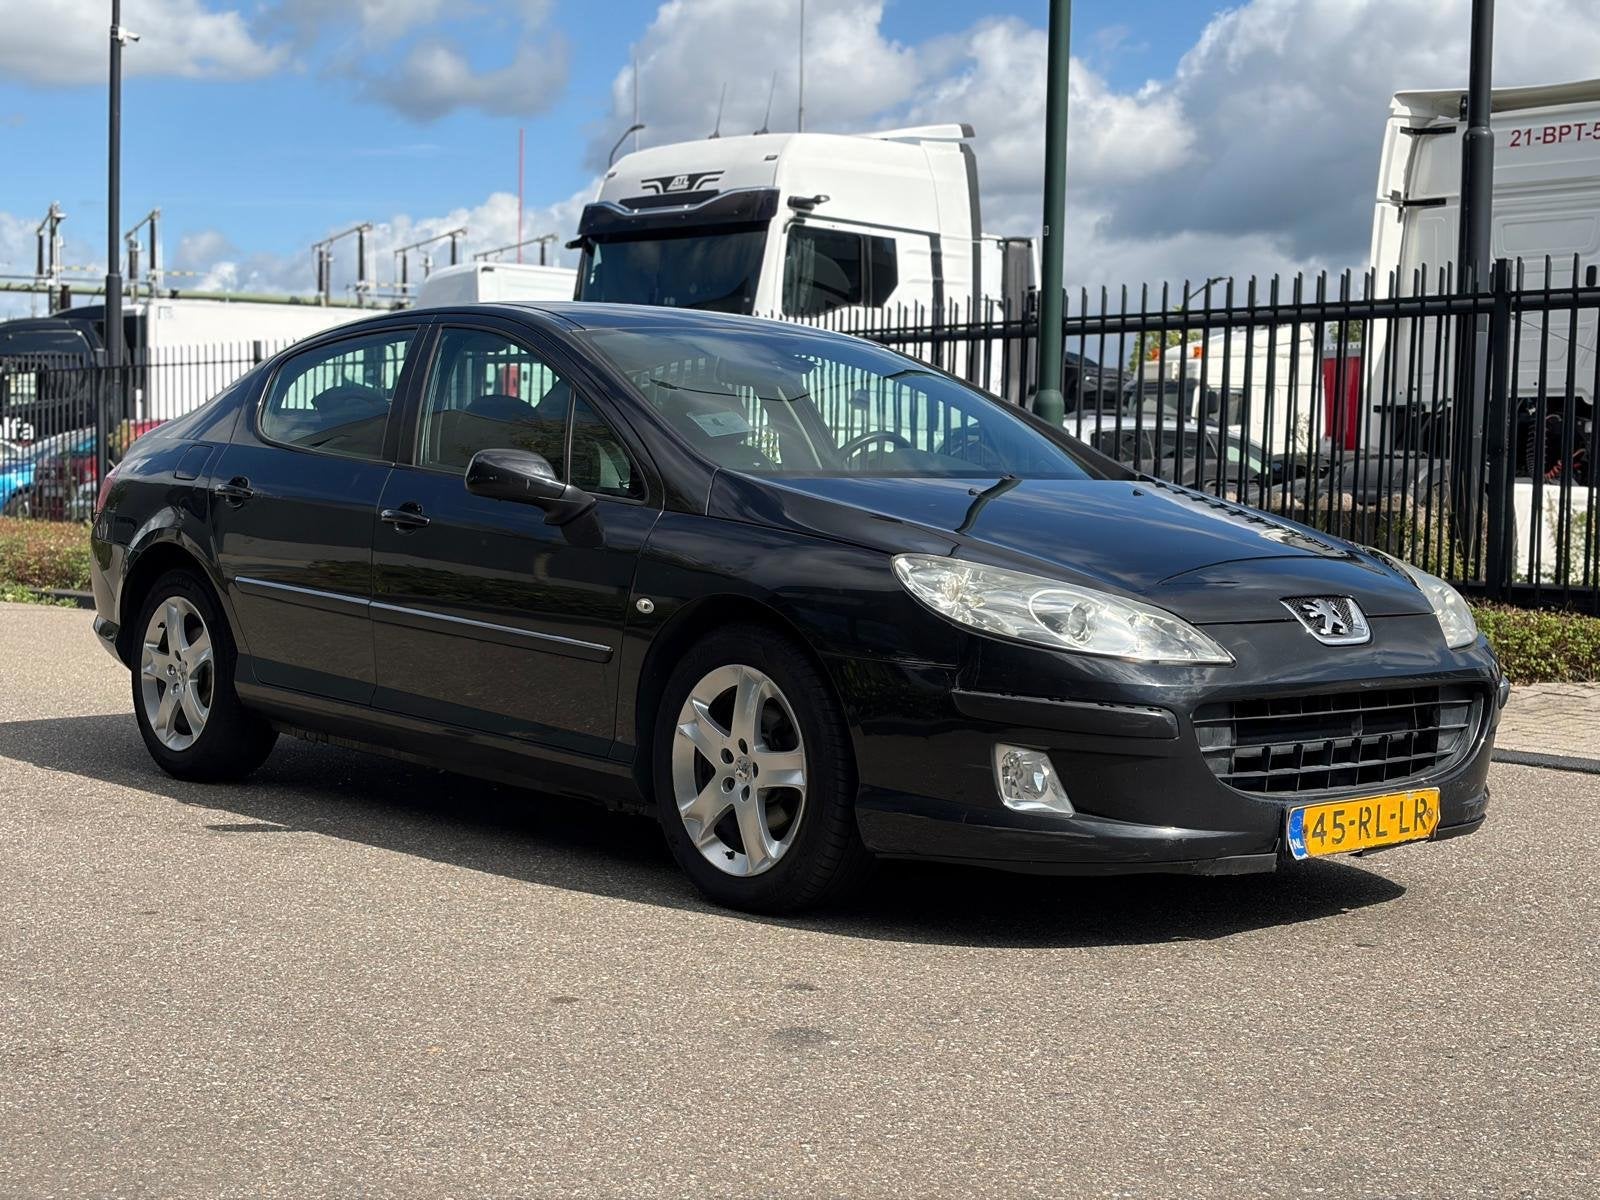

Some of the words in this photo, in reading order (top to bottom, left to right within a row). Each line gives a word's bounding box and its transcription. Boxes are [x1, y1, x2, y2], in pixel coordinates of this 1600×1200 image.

[1509, 122, 1600, 148] 21-BPT-5
[0, 416, 34, 440] lfa
[1312, 798, 1428, 847] 45-RL-LR
[1292, 838, 1304, 849] NL
